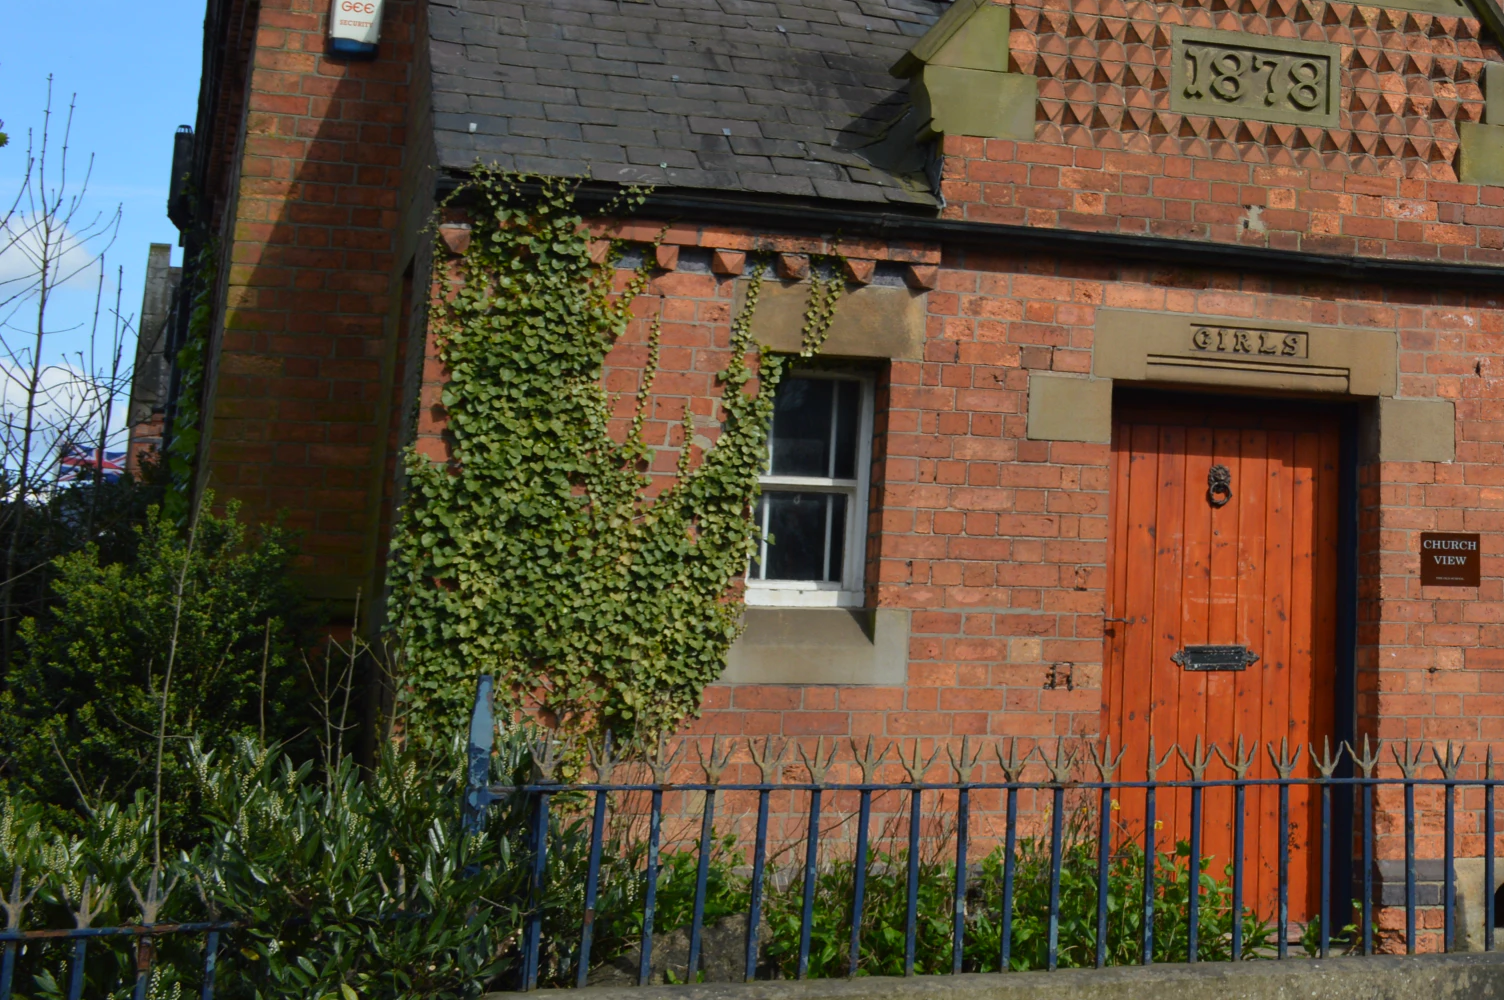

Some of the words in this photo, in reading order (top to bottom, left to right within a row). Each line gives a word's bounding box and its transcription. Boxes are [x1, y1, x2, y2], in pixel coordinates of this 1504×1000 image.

[341, 0, 375, 15] GEE
[340, 19, 374, 28] SECURITY
[1183, 46, 1325, 112] 1878
[1192, 327, 1300, 356] GIRLS
[1423, 539, 1477, 551] CHURCH
[1433, 555, 1467, 566] VIEW
